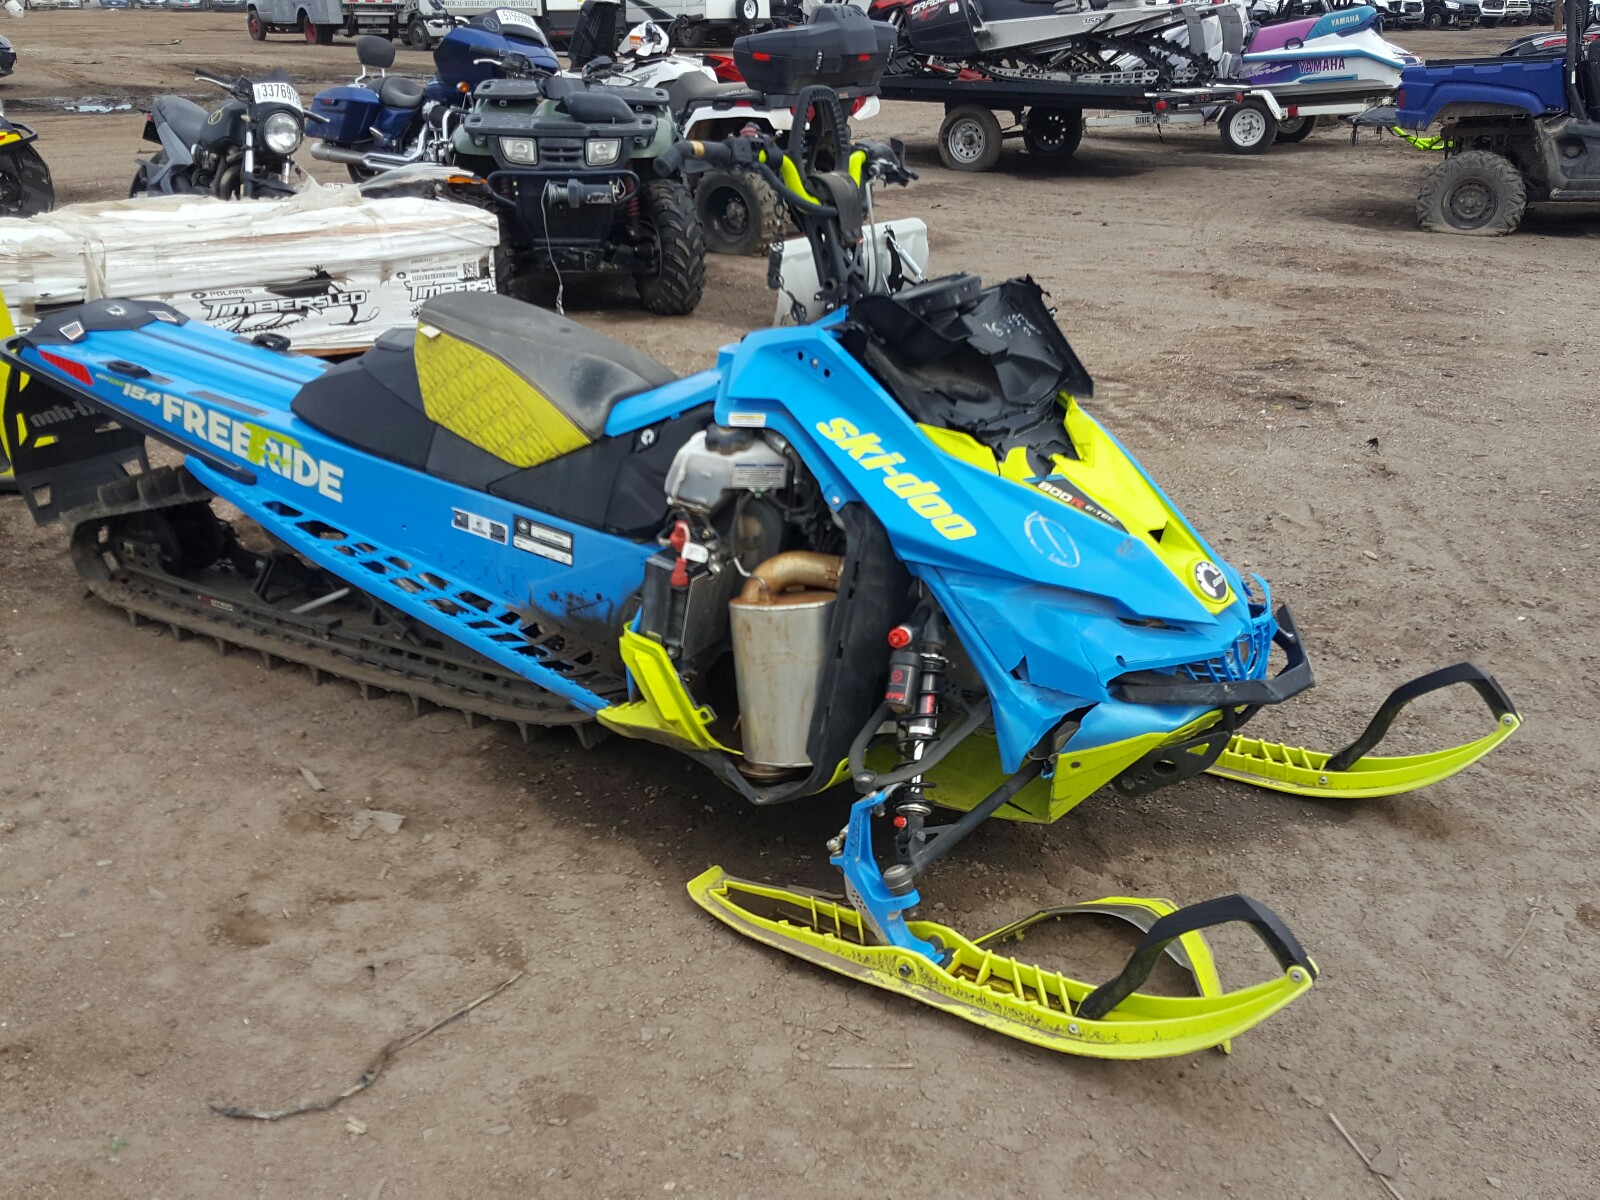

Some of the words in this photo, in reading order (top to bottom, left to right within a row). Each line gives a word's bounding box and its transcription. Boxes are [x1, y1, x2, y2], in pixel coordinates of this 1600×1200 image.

[1331, 14, 1360, 27] YAMAHA
[1299, 57, 1346, 74] YAMAHA
[209, 288, 252, 297] POLARIS
[200, 289, 368, 321] TIMBERSLED
[122, 383, 161, 406] 154
[163, 394, 345, 504] FREERIDE
[815, 417, 978, 541] ski-doo
